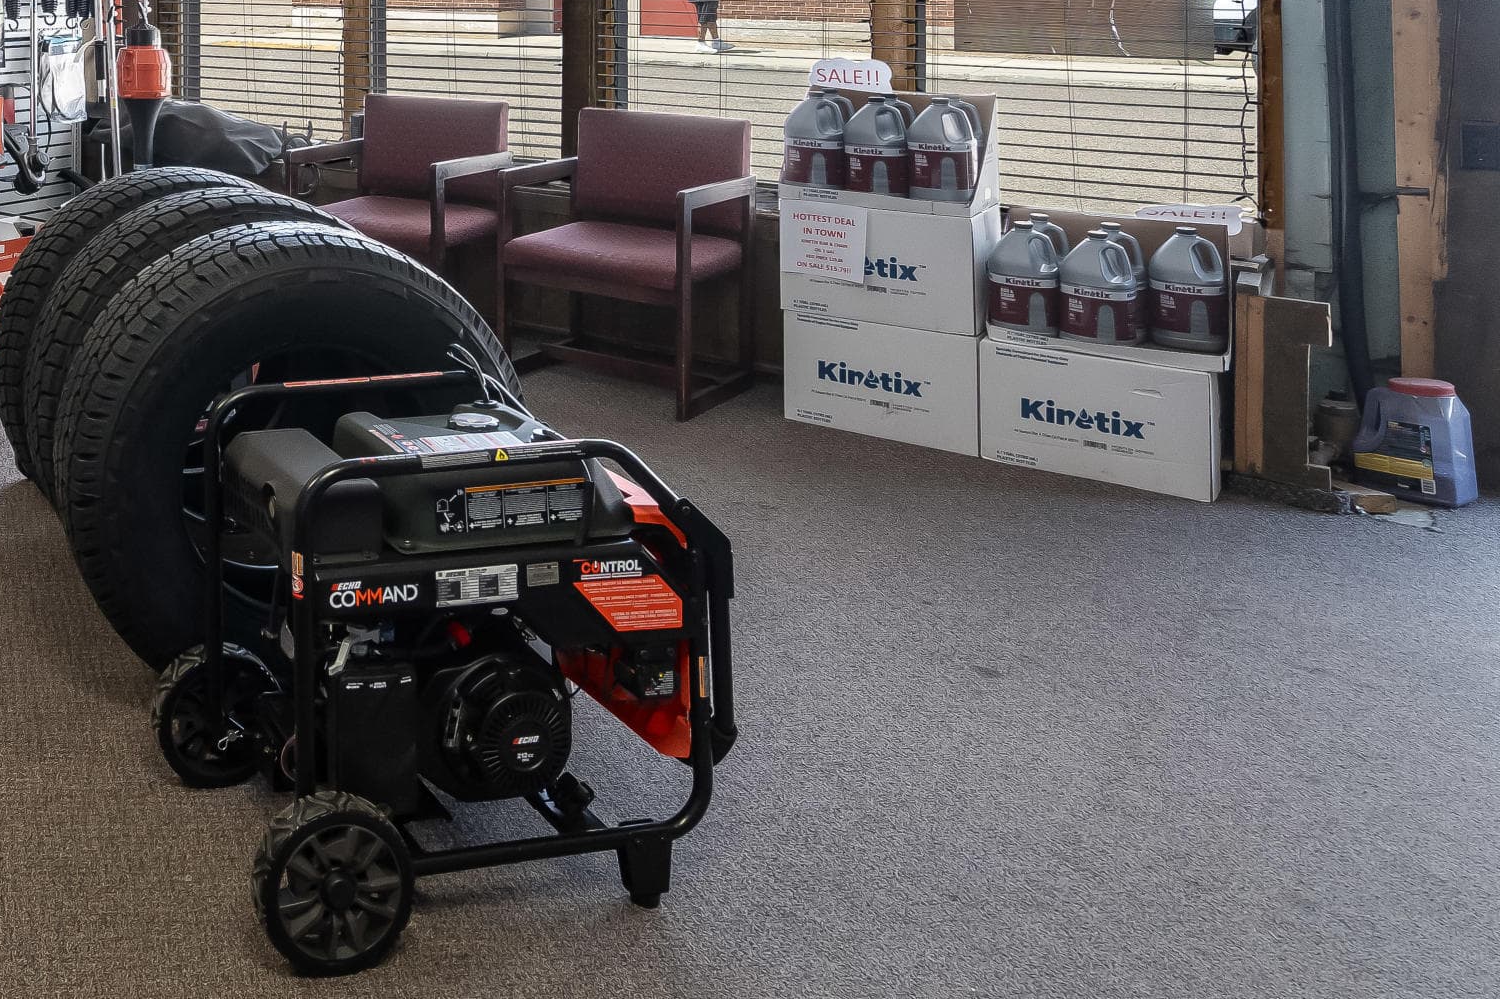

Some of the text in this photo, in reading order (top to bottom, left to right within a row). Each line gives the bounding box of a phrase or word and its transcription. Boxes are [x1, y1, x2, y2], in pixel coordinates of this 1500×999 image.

[816, 68, 880, 86] SALE!!
[793, 139, 822, 148] Kinetix
[918, 143, 951, 151] Kinetix
[853, 147, 883, 155] Kinetix
[792, 213, 856, 226] HOTTEST DEAL
[815, 228, 846, 239] TOWN!
[864, 256, 918, 282] etix
[1005, 277, 1041, 287] Kinetix
[1074, 288, 1111, 299] Kinetix
[1165, 283, 1203, 294] Kinetix
[817, 360, 923, 398] Kinetix
[1020, 397, 1146, 440] Kinetix
[337, 581, 361, 590] ECHO
[329, 584, 418, 608] COMMAND
[518, 735, 540, 744] ECHO
